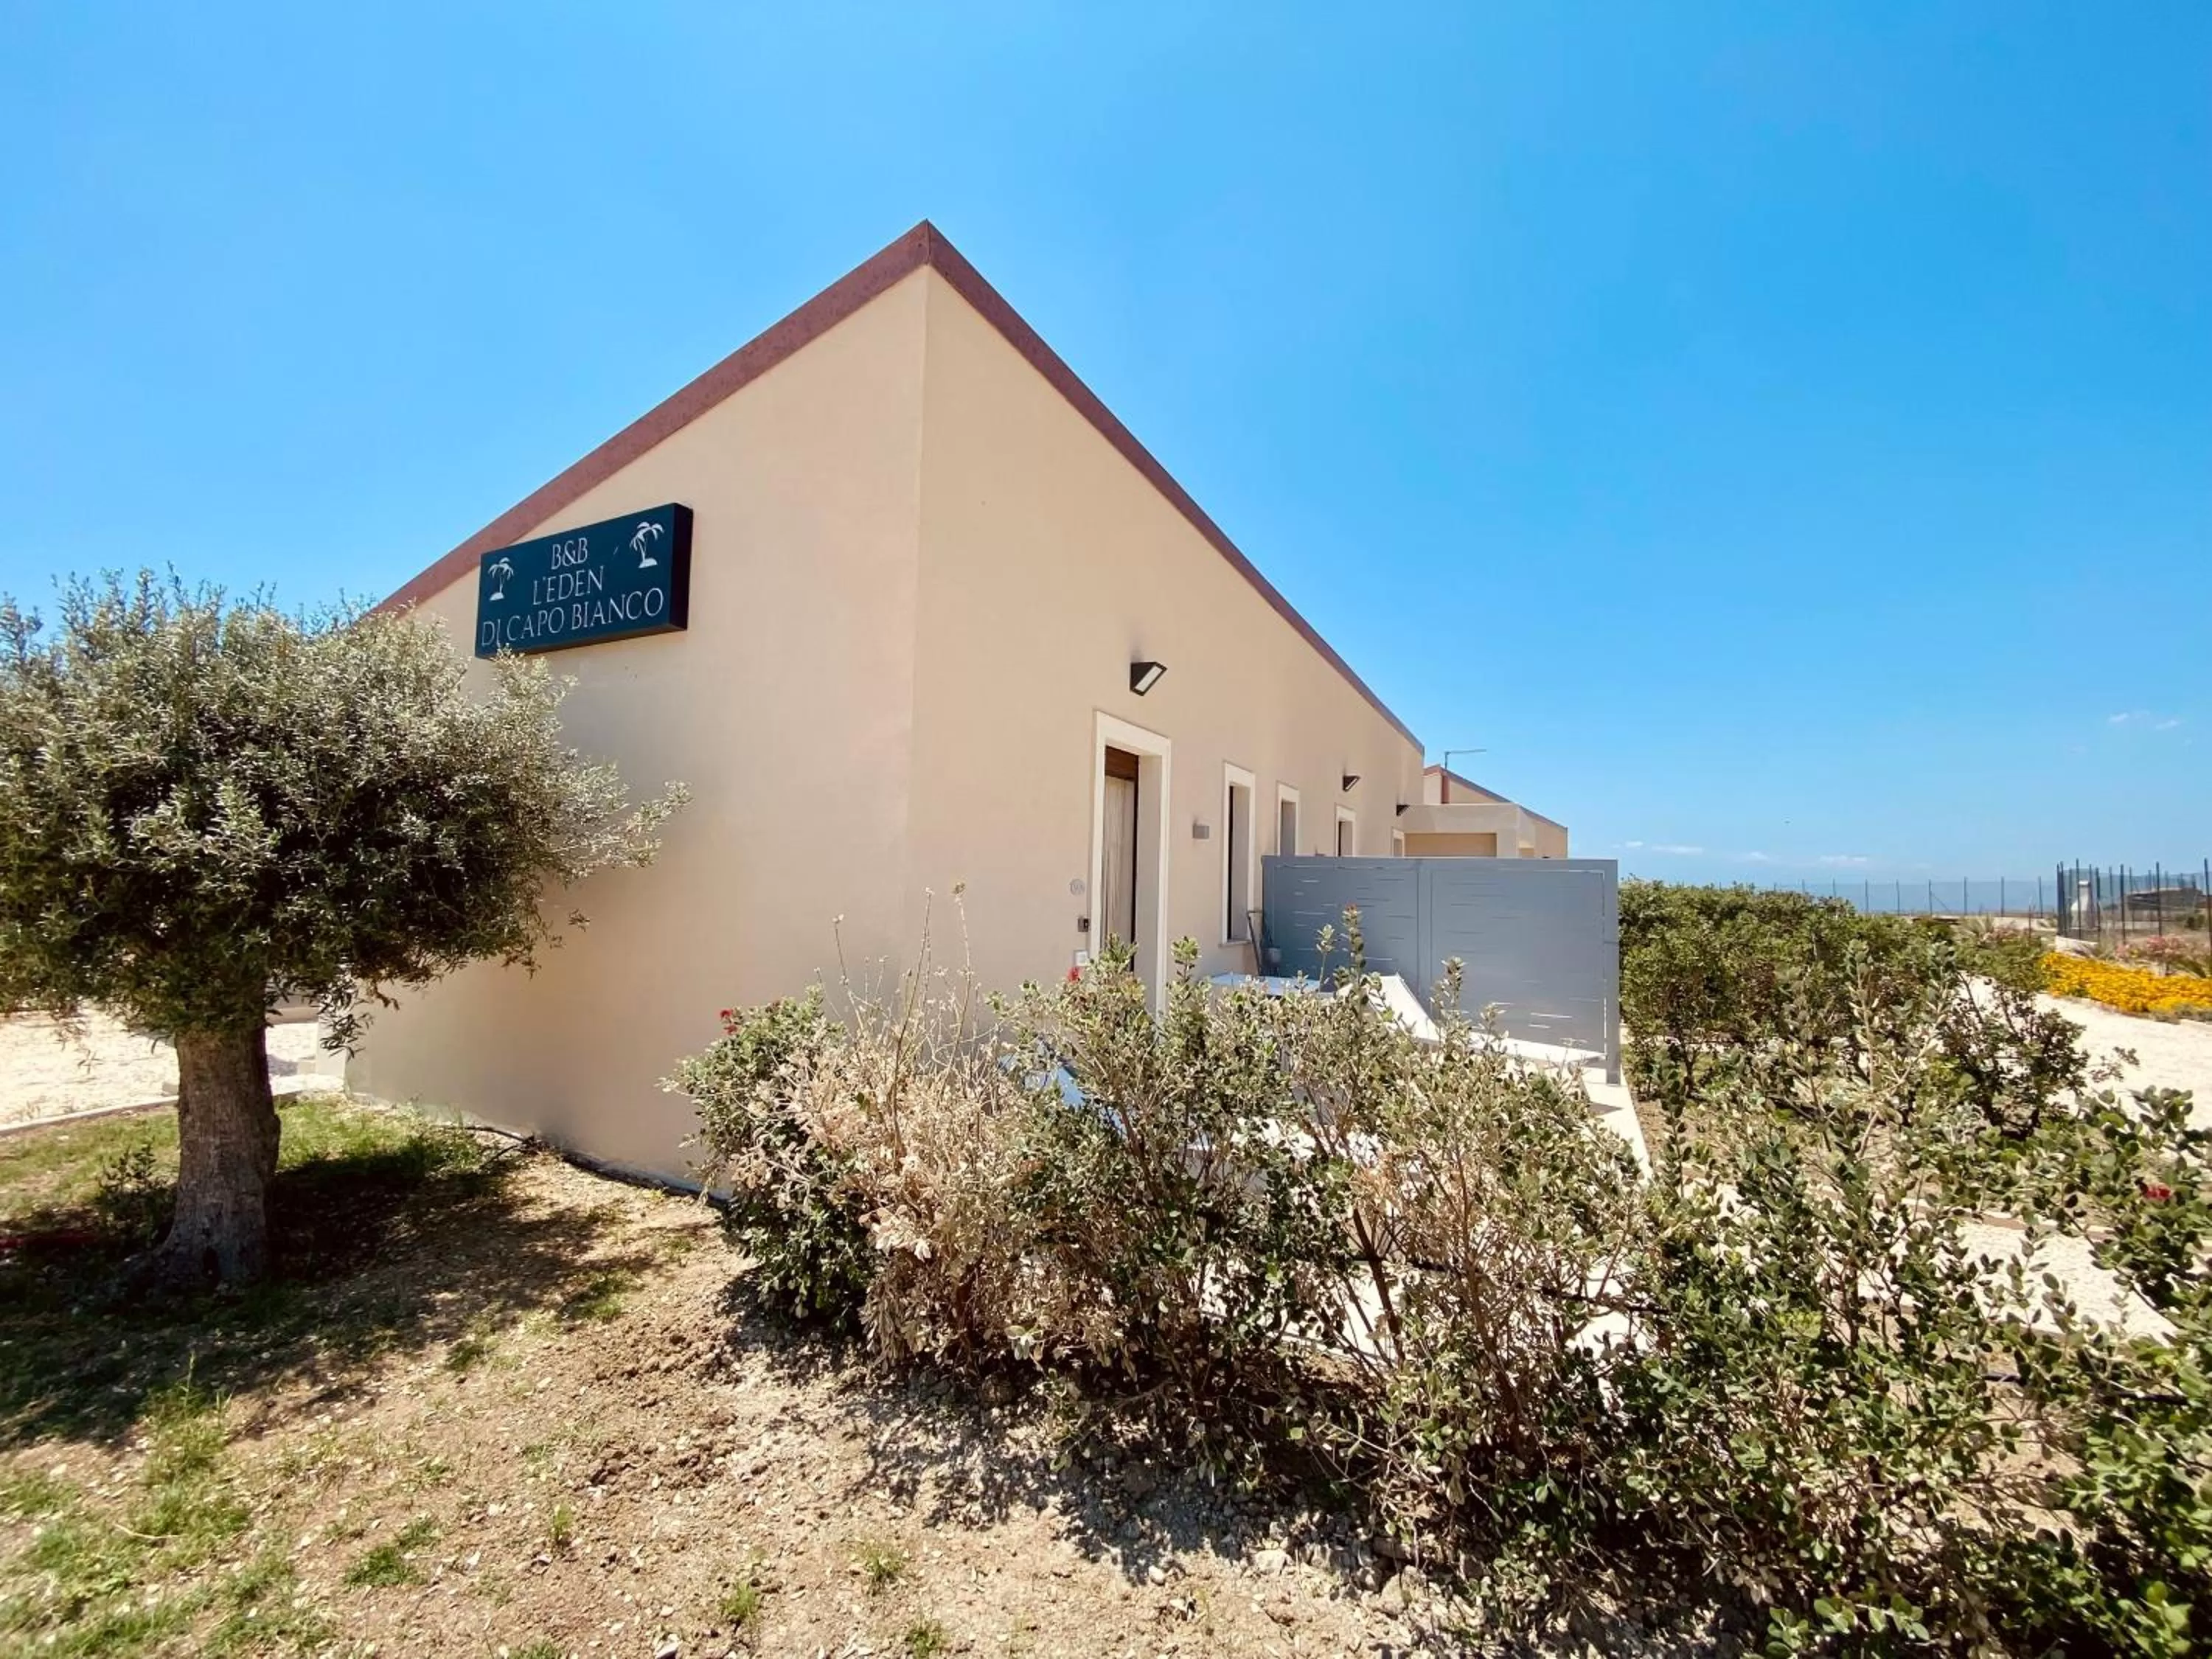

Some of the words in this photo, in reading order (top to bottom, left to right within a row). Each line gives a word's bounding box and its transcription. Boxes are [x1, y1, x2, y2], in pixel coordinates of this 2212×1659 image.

[551, 537, 588, 570] B&B
[532, 565, 605, 605] L'EDEN
[481, 619, 501, 647] DI
[507, 607, 565, 641] CAPO
[571, 587, 664, 630] BIANCO
